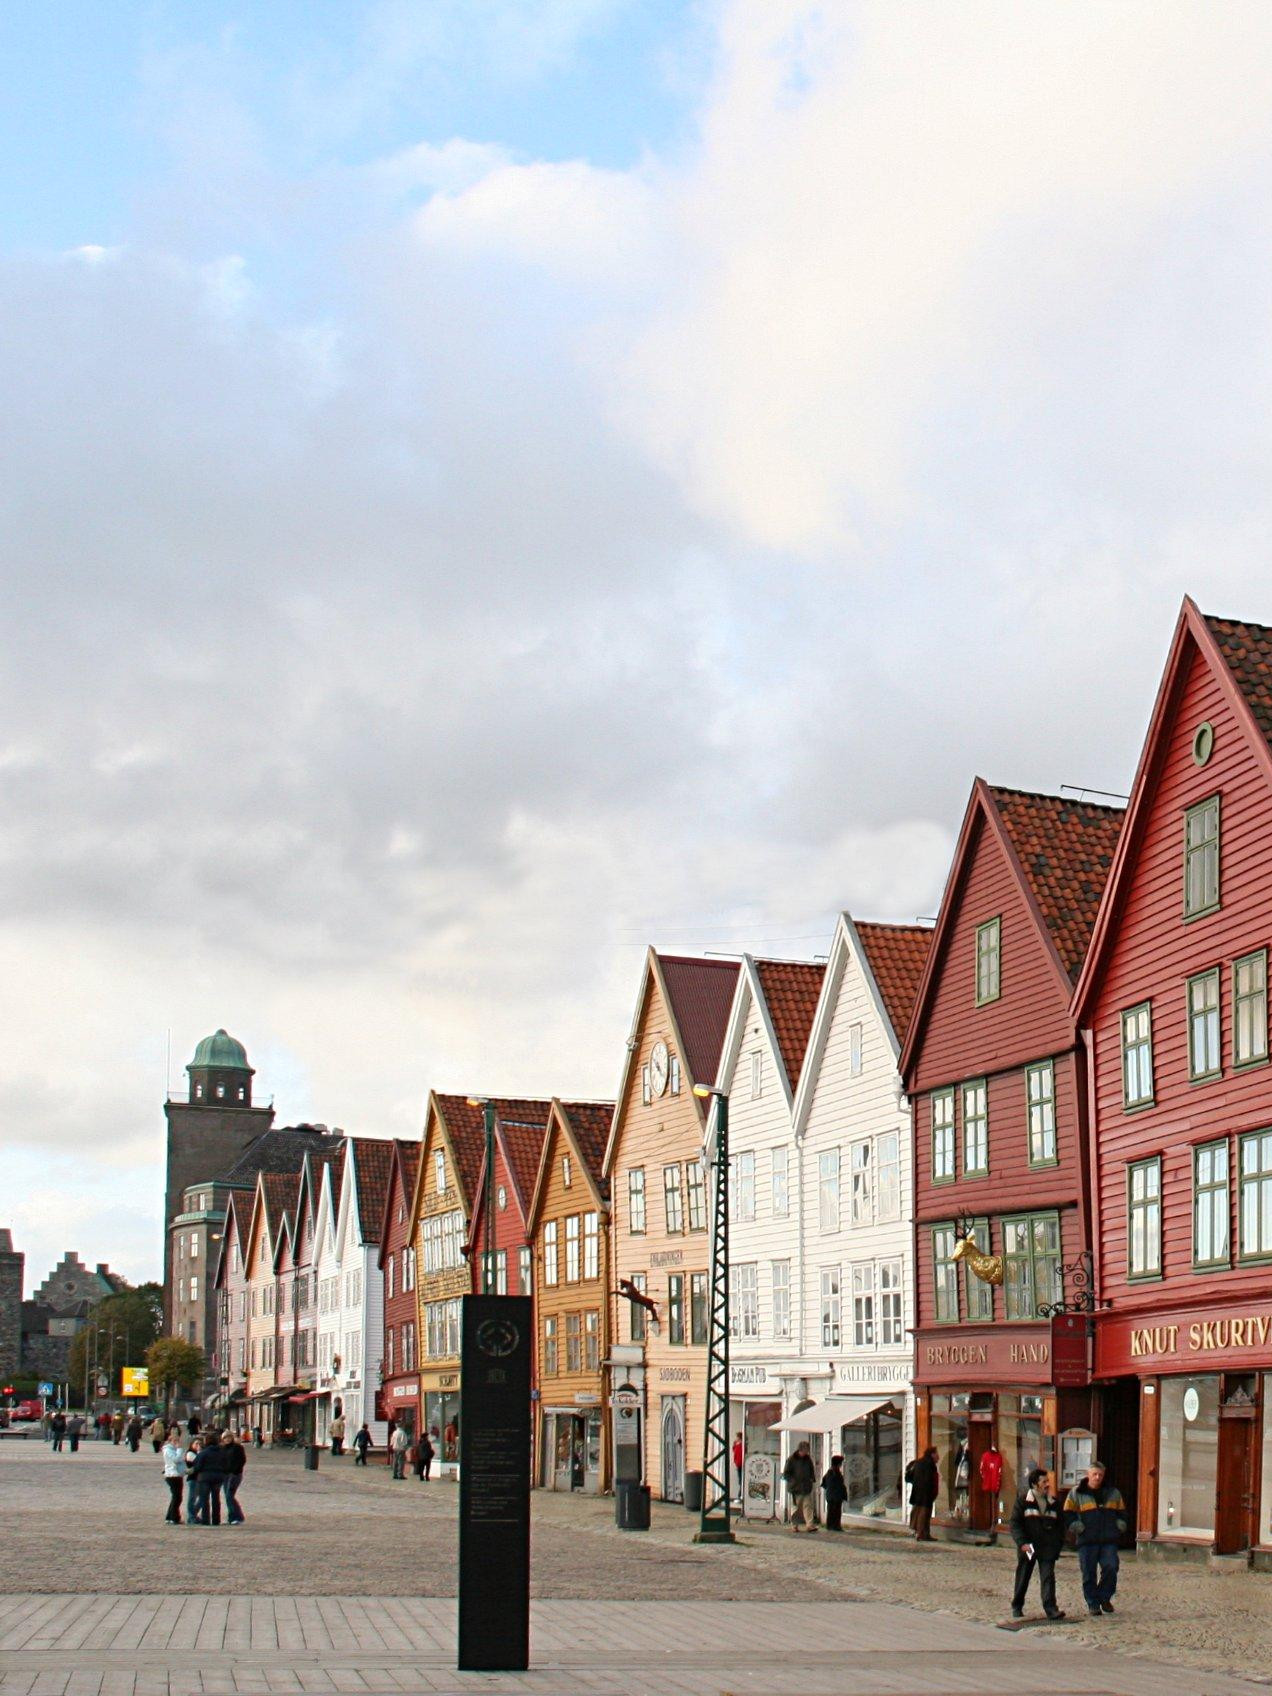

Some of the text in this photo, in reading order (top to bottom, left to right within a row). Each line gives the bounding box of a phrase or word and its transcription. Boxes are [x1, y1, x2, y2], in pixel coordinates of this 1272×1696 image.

[927, 1344, 1049, 1364] BRYGGEN HAND
[1131, 1326, 1179, 1357] KNUT
